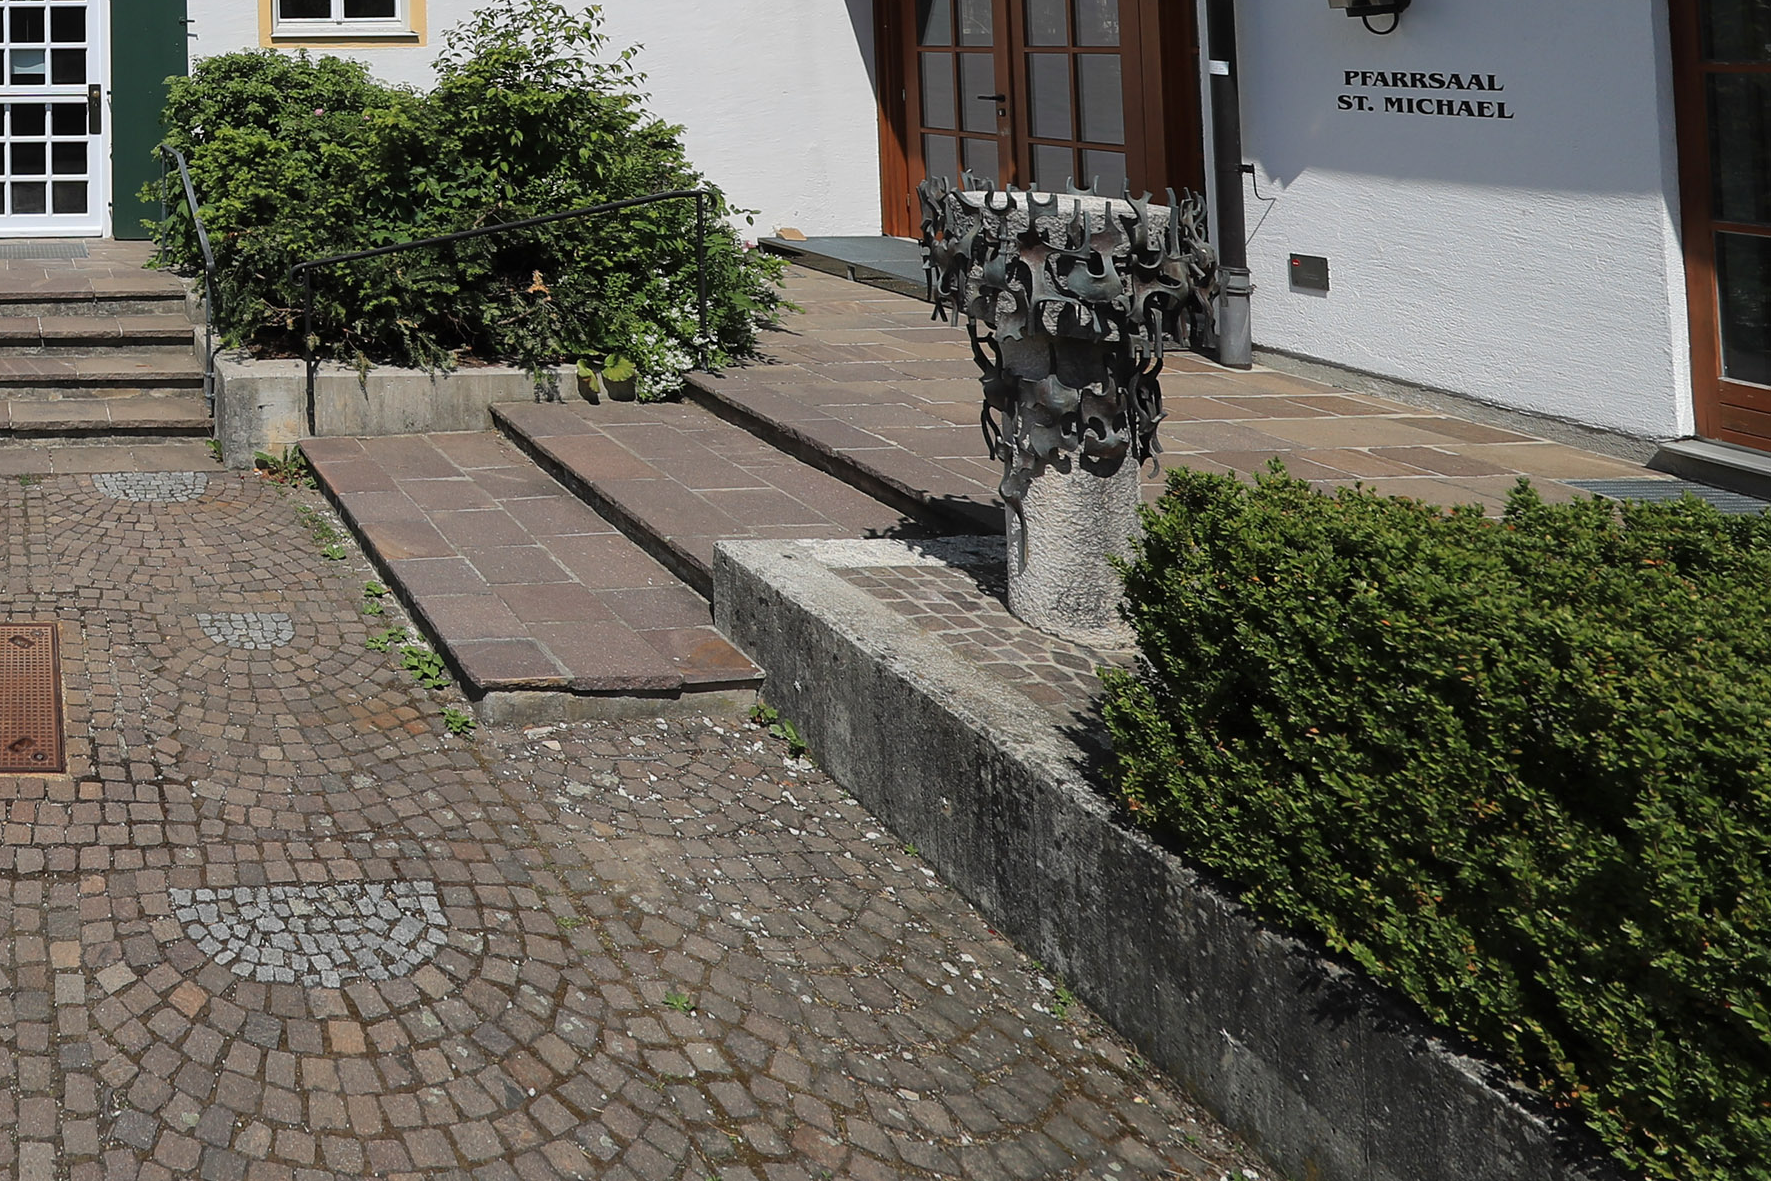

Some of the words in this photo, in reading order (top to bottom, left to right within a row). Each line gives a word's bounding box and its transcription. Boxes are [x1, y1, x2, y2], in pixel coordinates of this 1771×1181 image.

[1343, 70, 1505, 91] PFARRSAAL
[1337, 94, 1374, 112] ST.
[1384, 97, 1515, 119] MICHAEL
